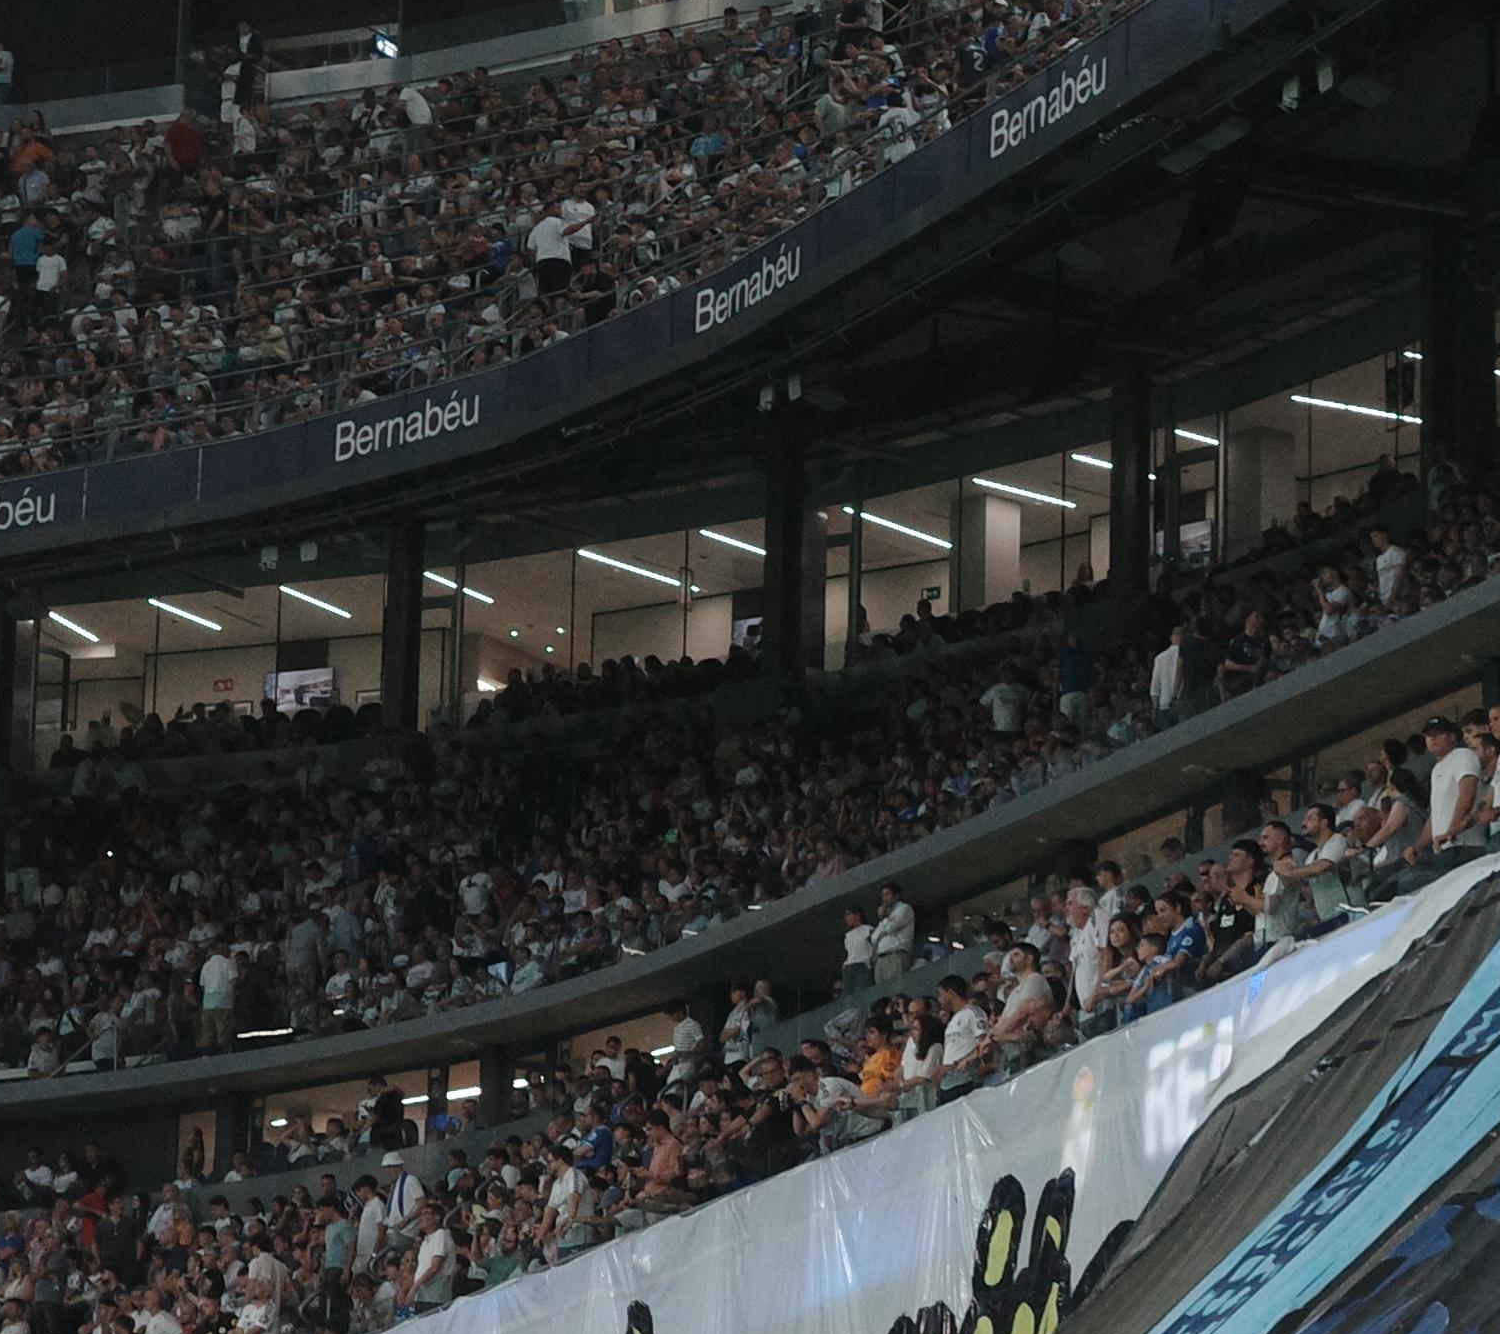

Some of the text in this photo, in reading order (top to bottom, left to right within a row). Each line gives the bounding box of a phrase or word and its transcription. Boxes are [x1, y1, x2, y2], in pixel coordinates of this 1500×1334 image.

[988, 55, 1109, 159] Bernabéu
[695, 245, 802, 335] Bernabéu
[334, 393, 481, 463] Bernabéu
